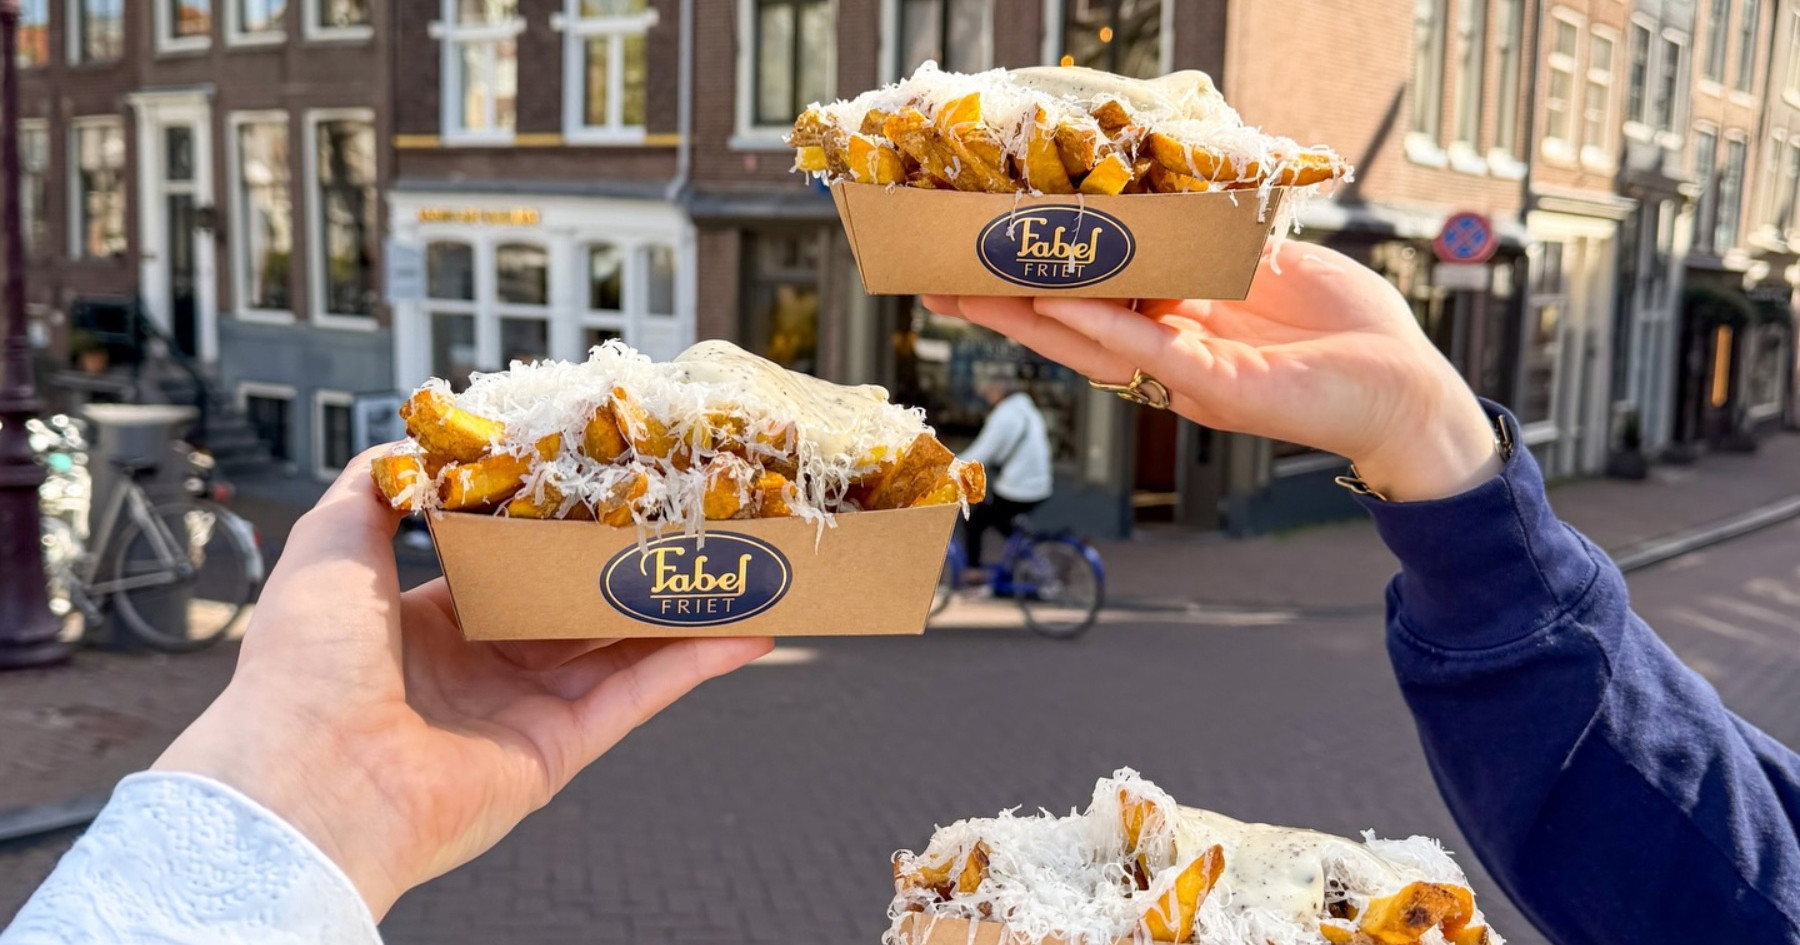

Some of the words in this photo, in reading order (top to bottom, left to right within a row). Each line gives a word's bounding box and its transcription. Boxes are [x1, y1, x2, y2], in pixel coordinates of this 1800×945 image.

[1007, 217, 1103, 264] Fabel
[1024, 263, 1086, 278] FRIET
[640, 546, 752, 597] Fabel
[661, 598, 735, 614] FRIET
